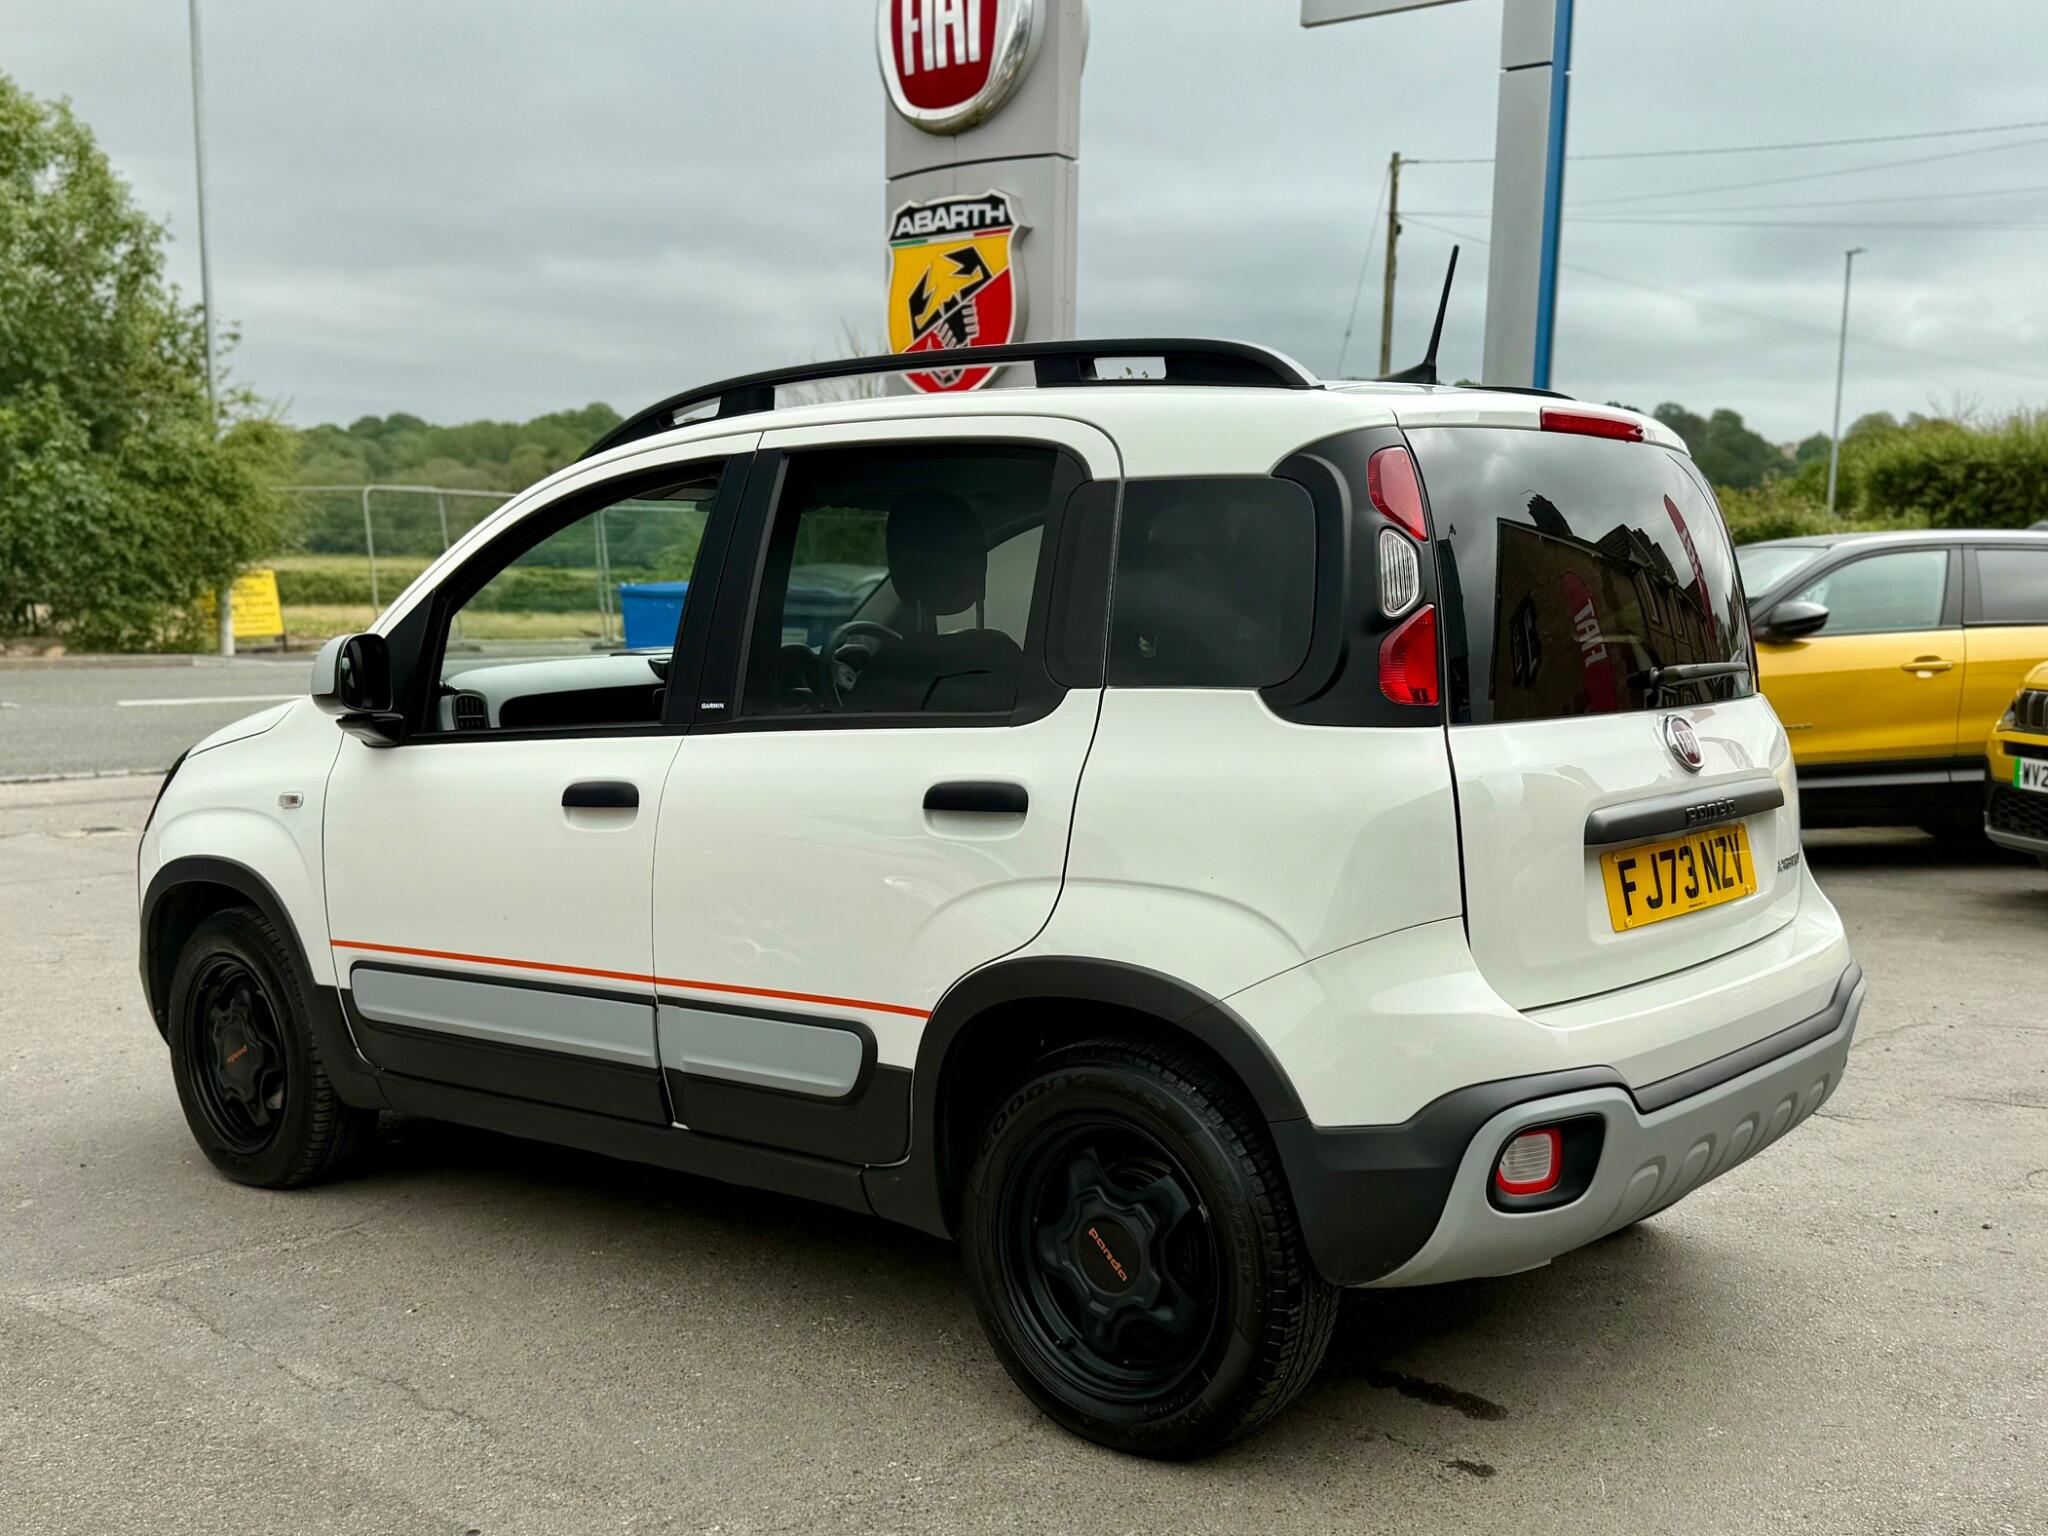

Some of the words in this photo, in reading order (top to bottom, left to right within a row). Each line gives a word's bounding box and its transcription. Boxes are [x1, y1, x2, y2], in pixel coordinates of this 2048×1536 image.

[901, 0, 981, 76] FIAT
[895, 203, 1005, 237] ABARTH
[1617, 844, 1699, 916] FJ73
[1700, 832, 1744, 894] NZV
[1088, 1227, 1128, 1282] panda
